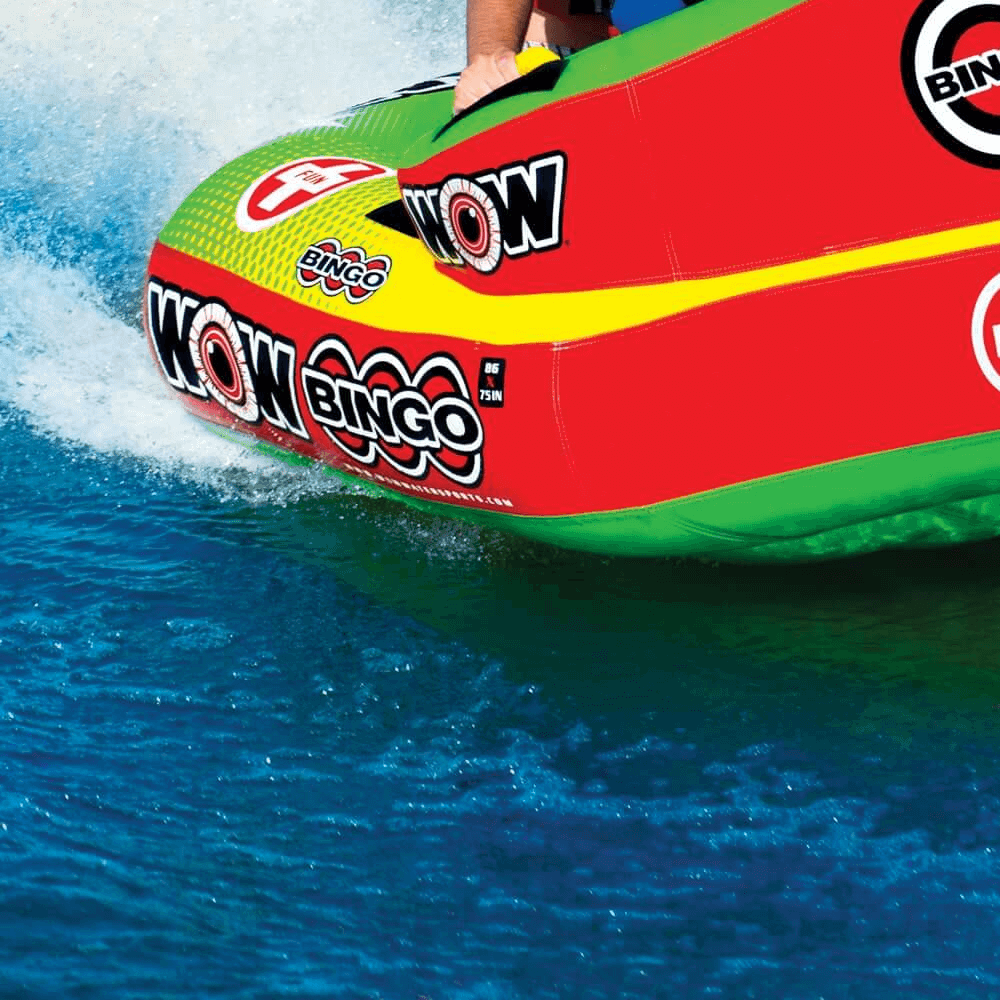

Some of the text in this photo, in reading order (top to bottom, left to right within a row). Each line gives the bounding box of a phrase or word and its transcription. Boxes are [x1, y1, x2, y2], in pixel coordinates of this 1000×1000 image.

[295, 170, 327, 185] FUN
[401, 153, 566, 273] WOW
[299, 247, 387, 289] BINGO
[147, 279, 311, 440] WOW
[302, 365, 484, 452] BINGO
